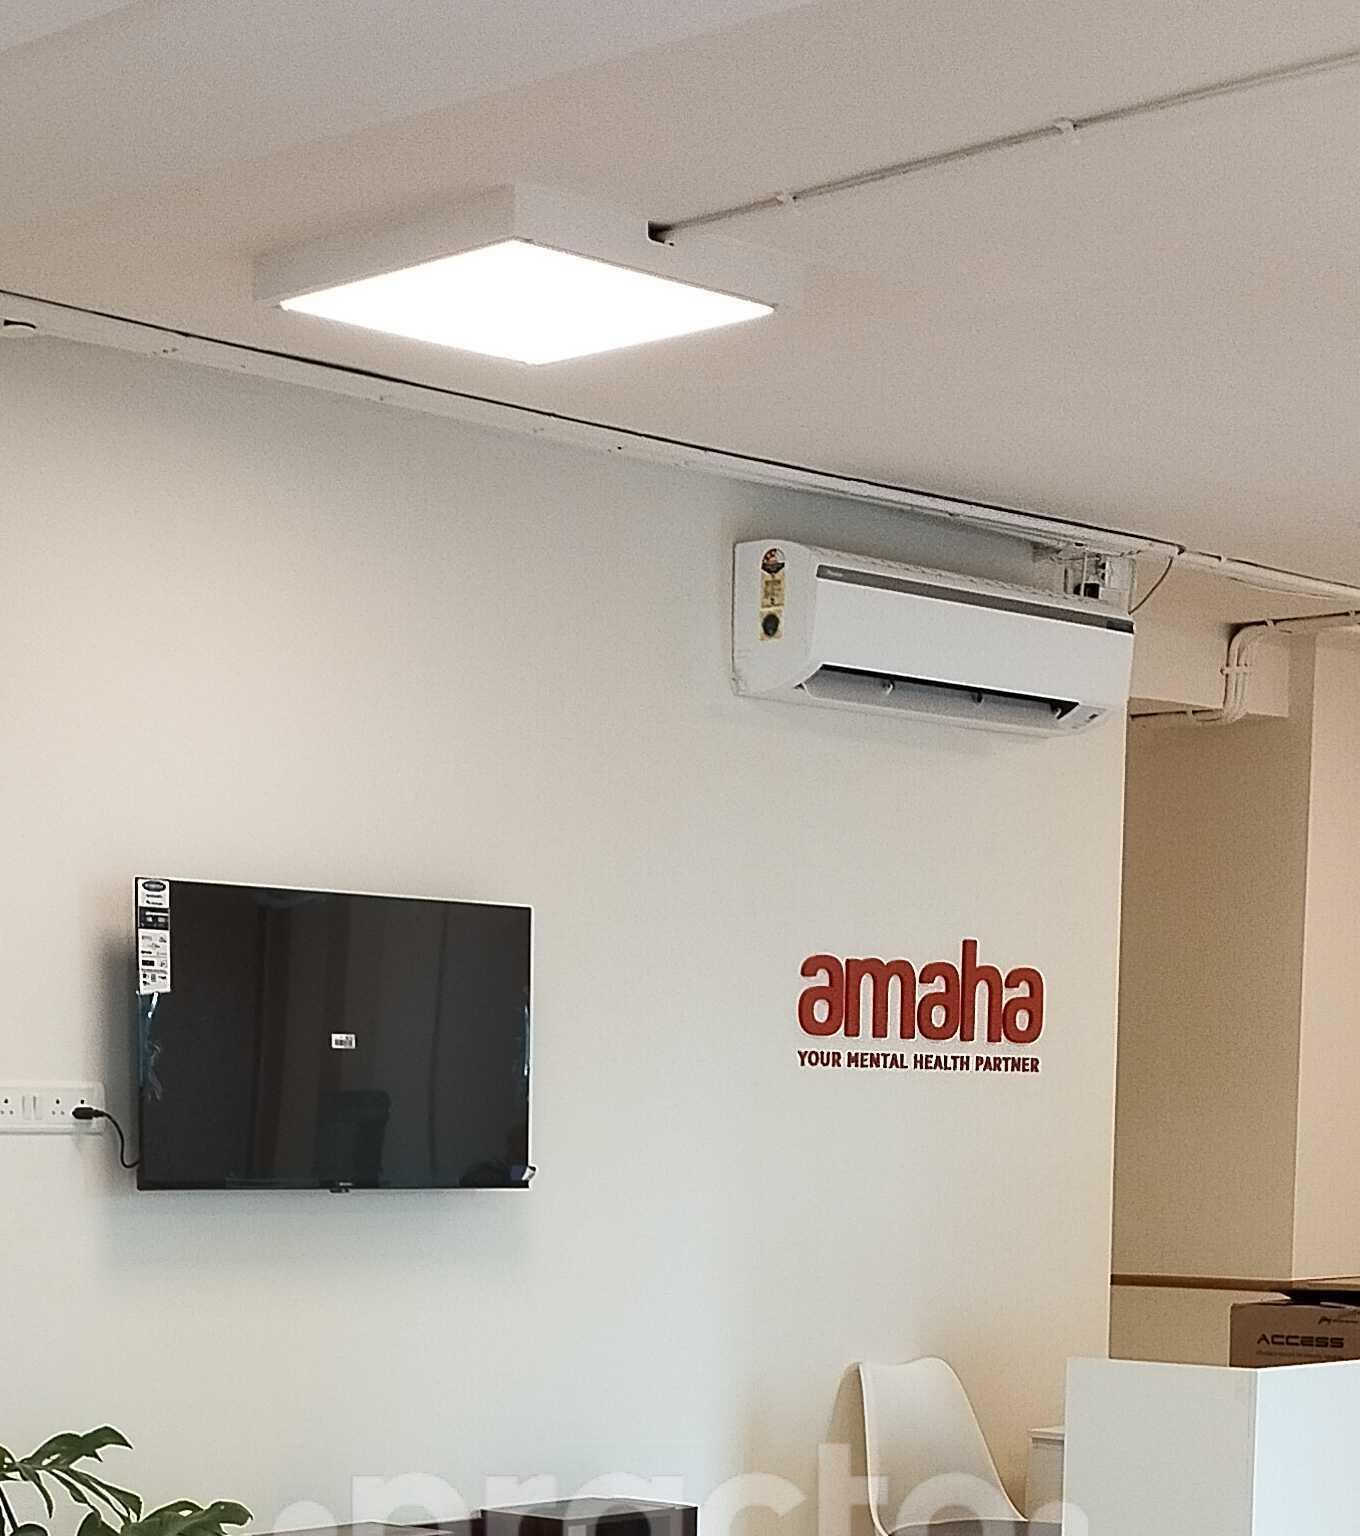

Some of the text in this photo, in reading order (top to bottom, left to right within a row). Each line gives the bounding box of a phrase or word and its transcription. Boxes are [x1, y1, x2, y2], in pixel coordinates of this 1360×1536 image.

[797, 938, 1044, 1044] amaha
[797, 1049, 1040, 1073] YOUR MENTAL HEALTH PARTNER
[1257, 1333, 1344, 1348] ACCESS
